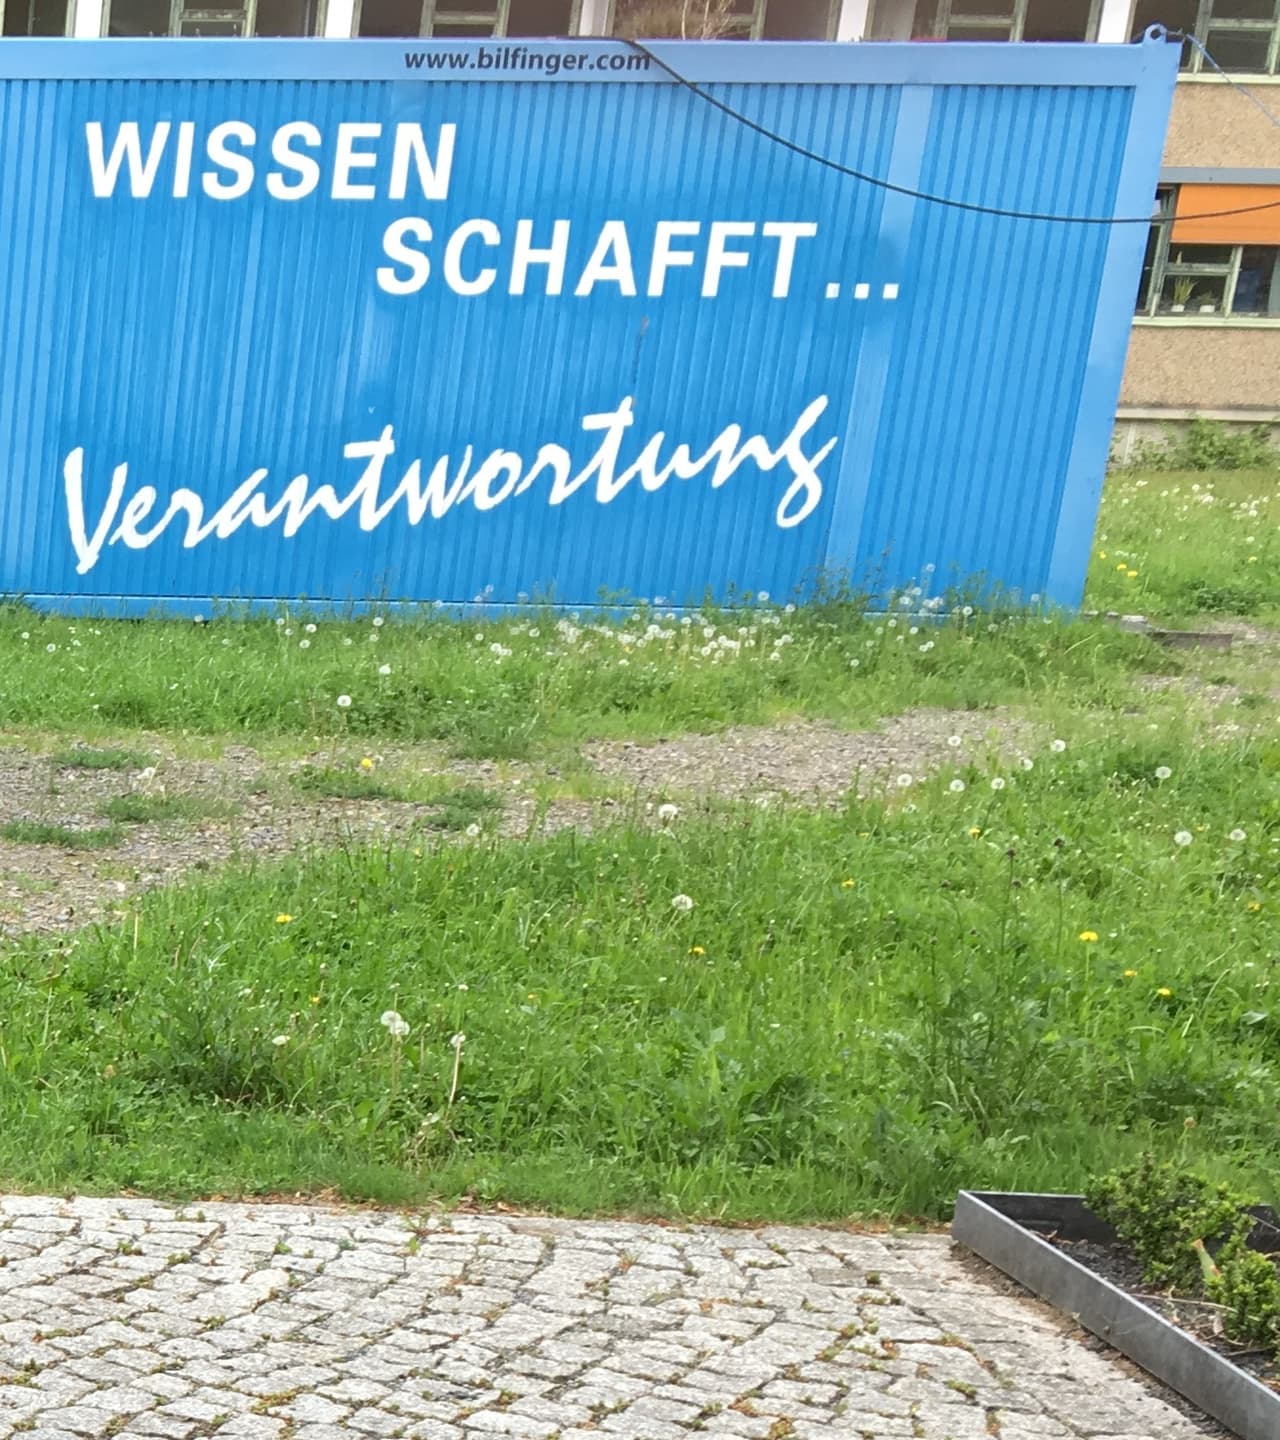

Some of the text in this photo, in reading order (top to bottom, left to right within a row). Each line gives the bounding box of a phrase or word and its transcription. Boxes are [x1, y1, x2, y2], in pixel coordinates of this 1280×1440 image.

[405, 46, 650, 75] www.bilfinger.com
[85, 121, 456, 200] WISSEN
[64, 395, 836, 574] Verantwortung
